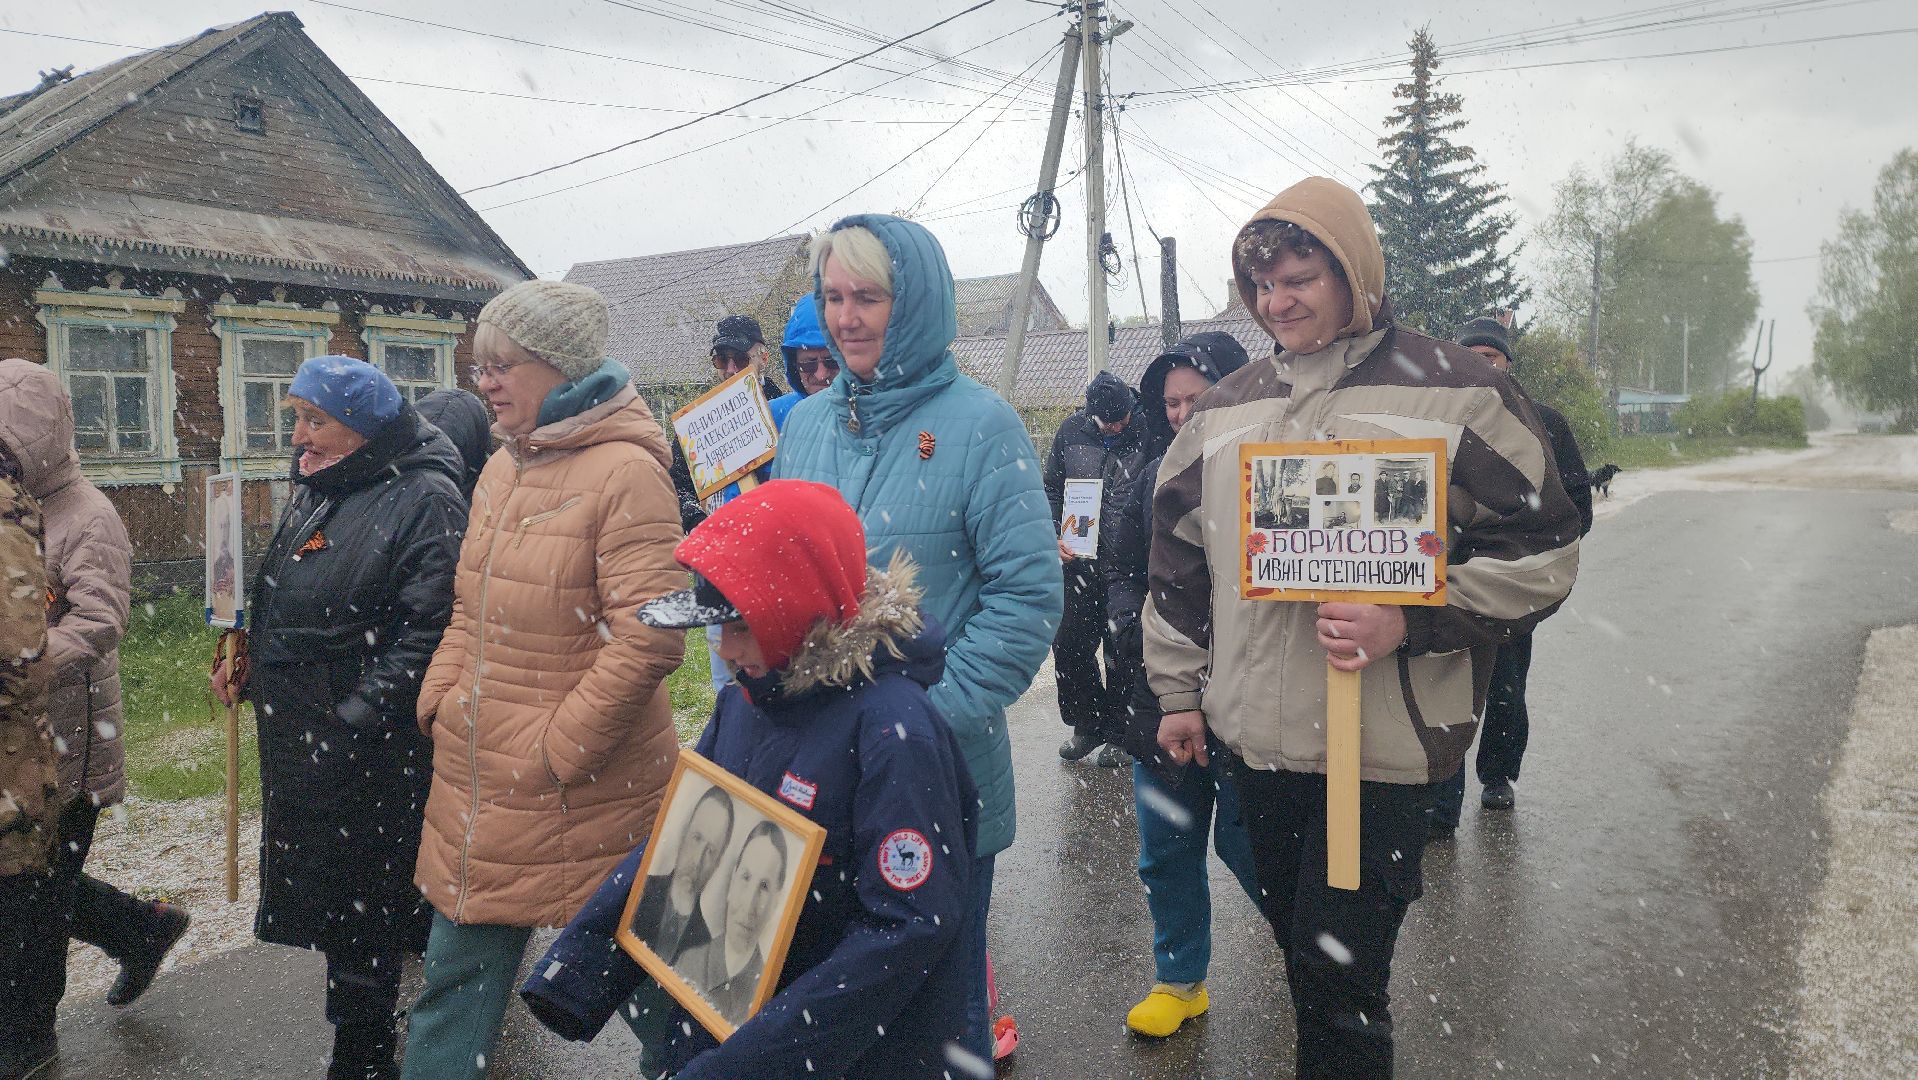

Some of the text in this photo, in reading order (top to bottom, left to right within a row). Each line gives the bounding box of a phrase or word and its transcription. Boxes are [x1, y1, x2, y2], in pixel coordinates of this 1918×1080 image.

[687, 391, 749, 439] АНИСИМОВ
[696, 406, 755, 453] АЛЕКСАНДР
[1271, 529, 1409, 555] БОРИСОВ
[1258, 557, 1426, 586] ИВАН СТЕПАНОВИЧ
